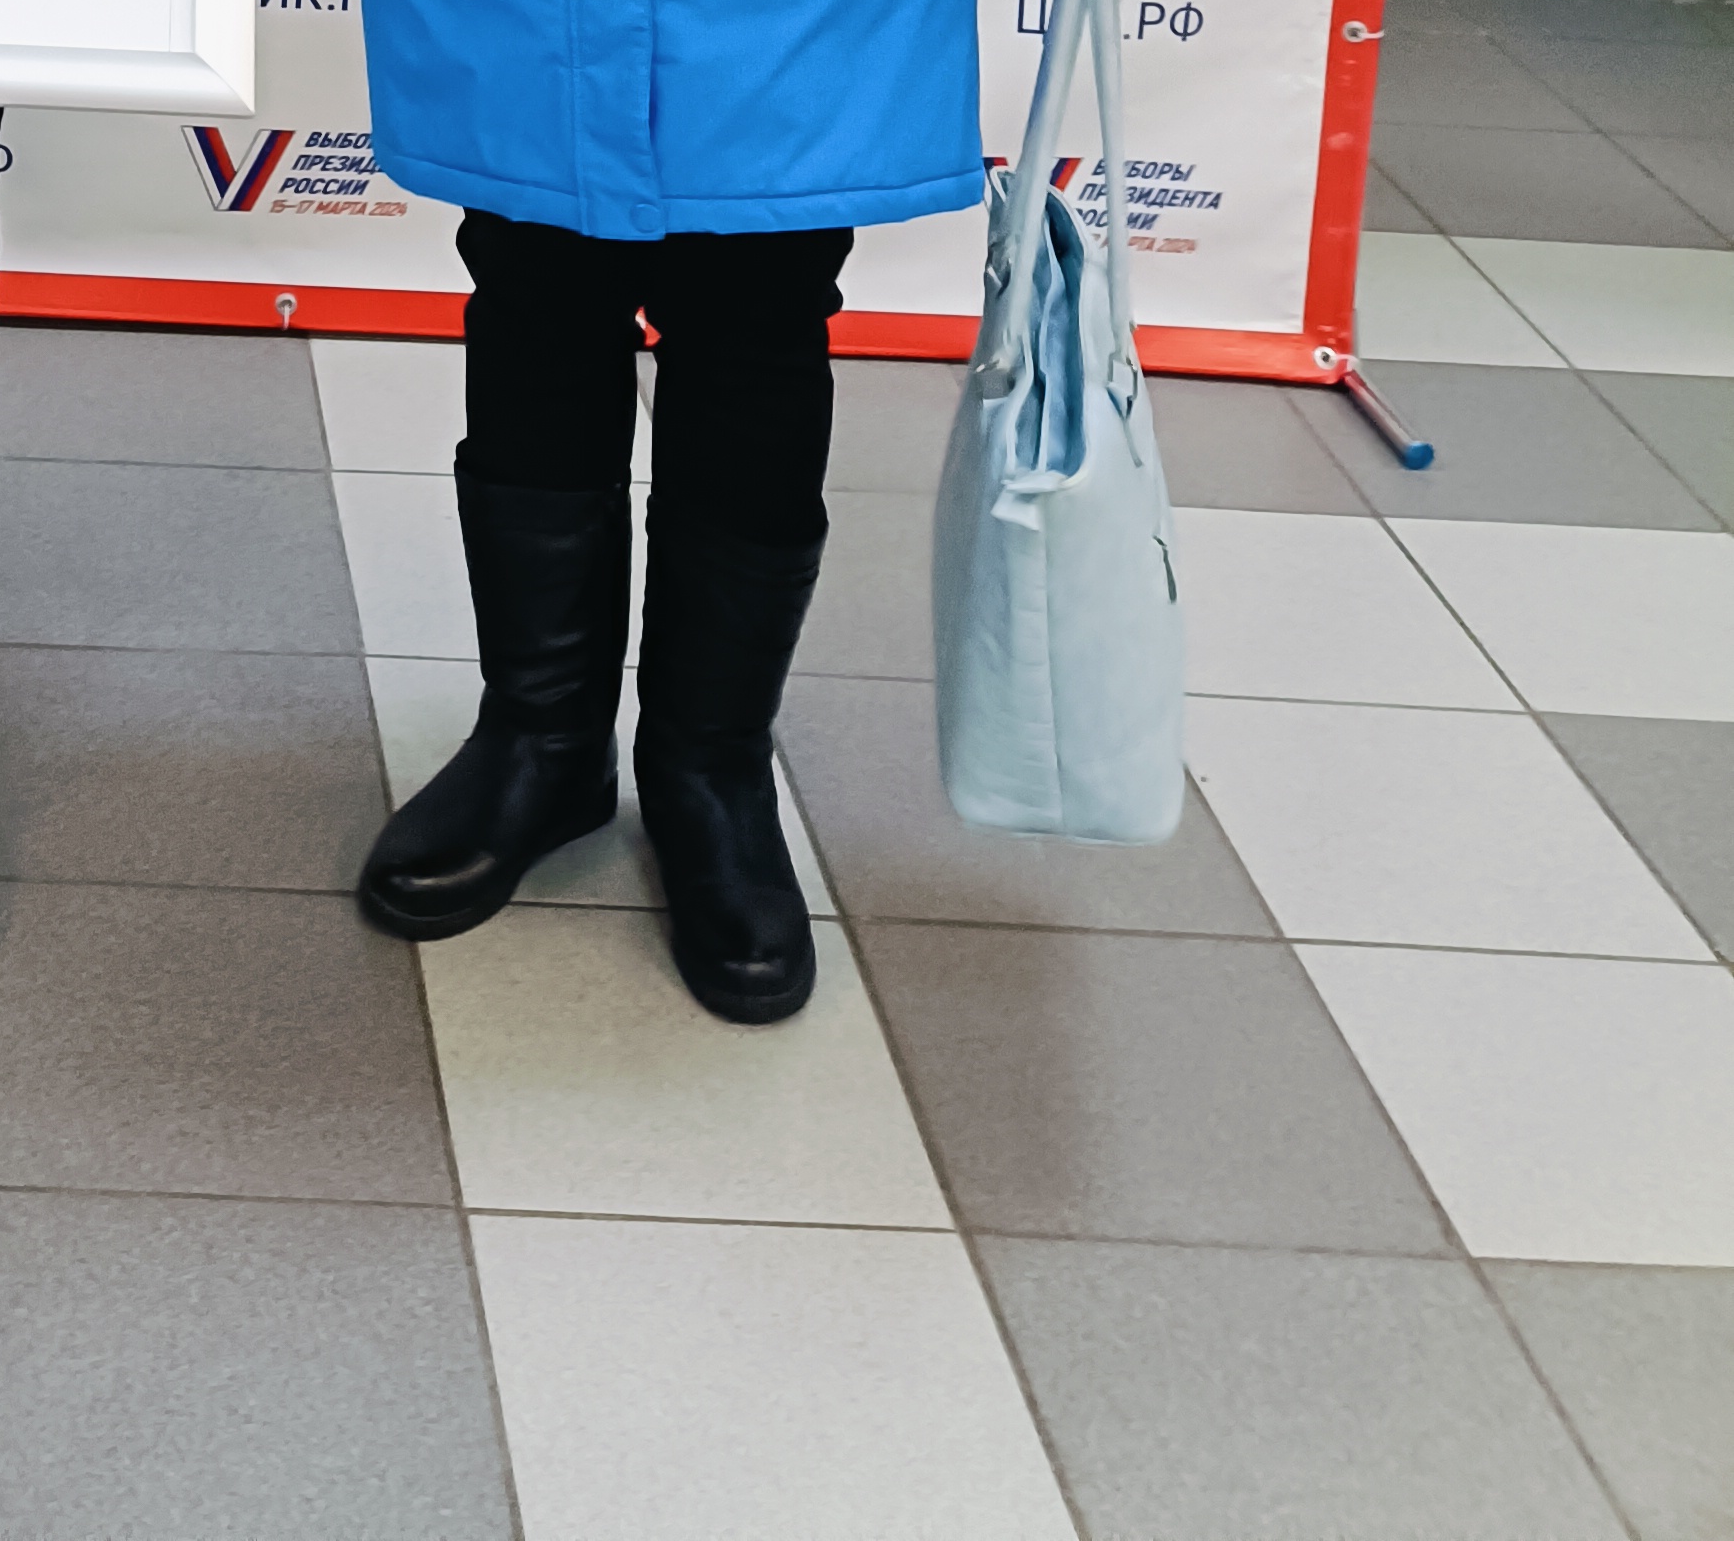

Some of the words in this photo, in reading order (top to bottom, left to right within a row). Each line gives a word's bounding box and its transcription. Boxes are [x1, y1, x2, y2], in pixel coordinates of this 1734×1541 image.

[292, 155, 382, 175] ПРЕЗИД
[1092, 158, 1196, 181] ВБОРЫ
[278, 178, 370, 195] РОССИИ
[1078, 183, 1223, 210] ПРЗИДЕНТА
[313, 201, 368, 215] МАРТА
